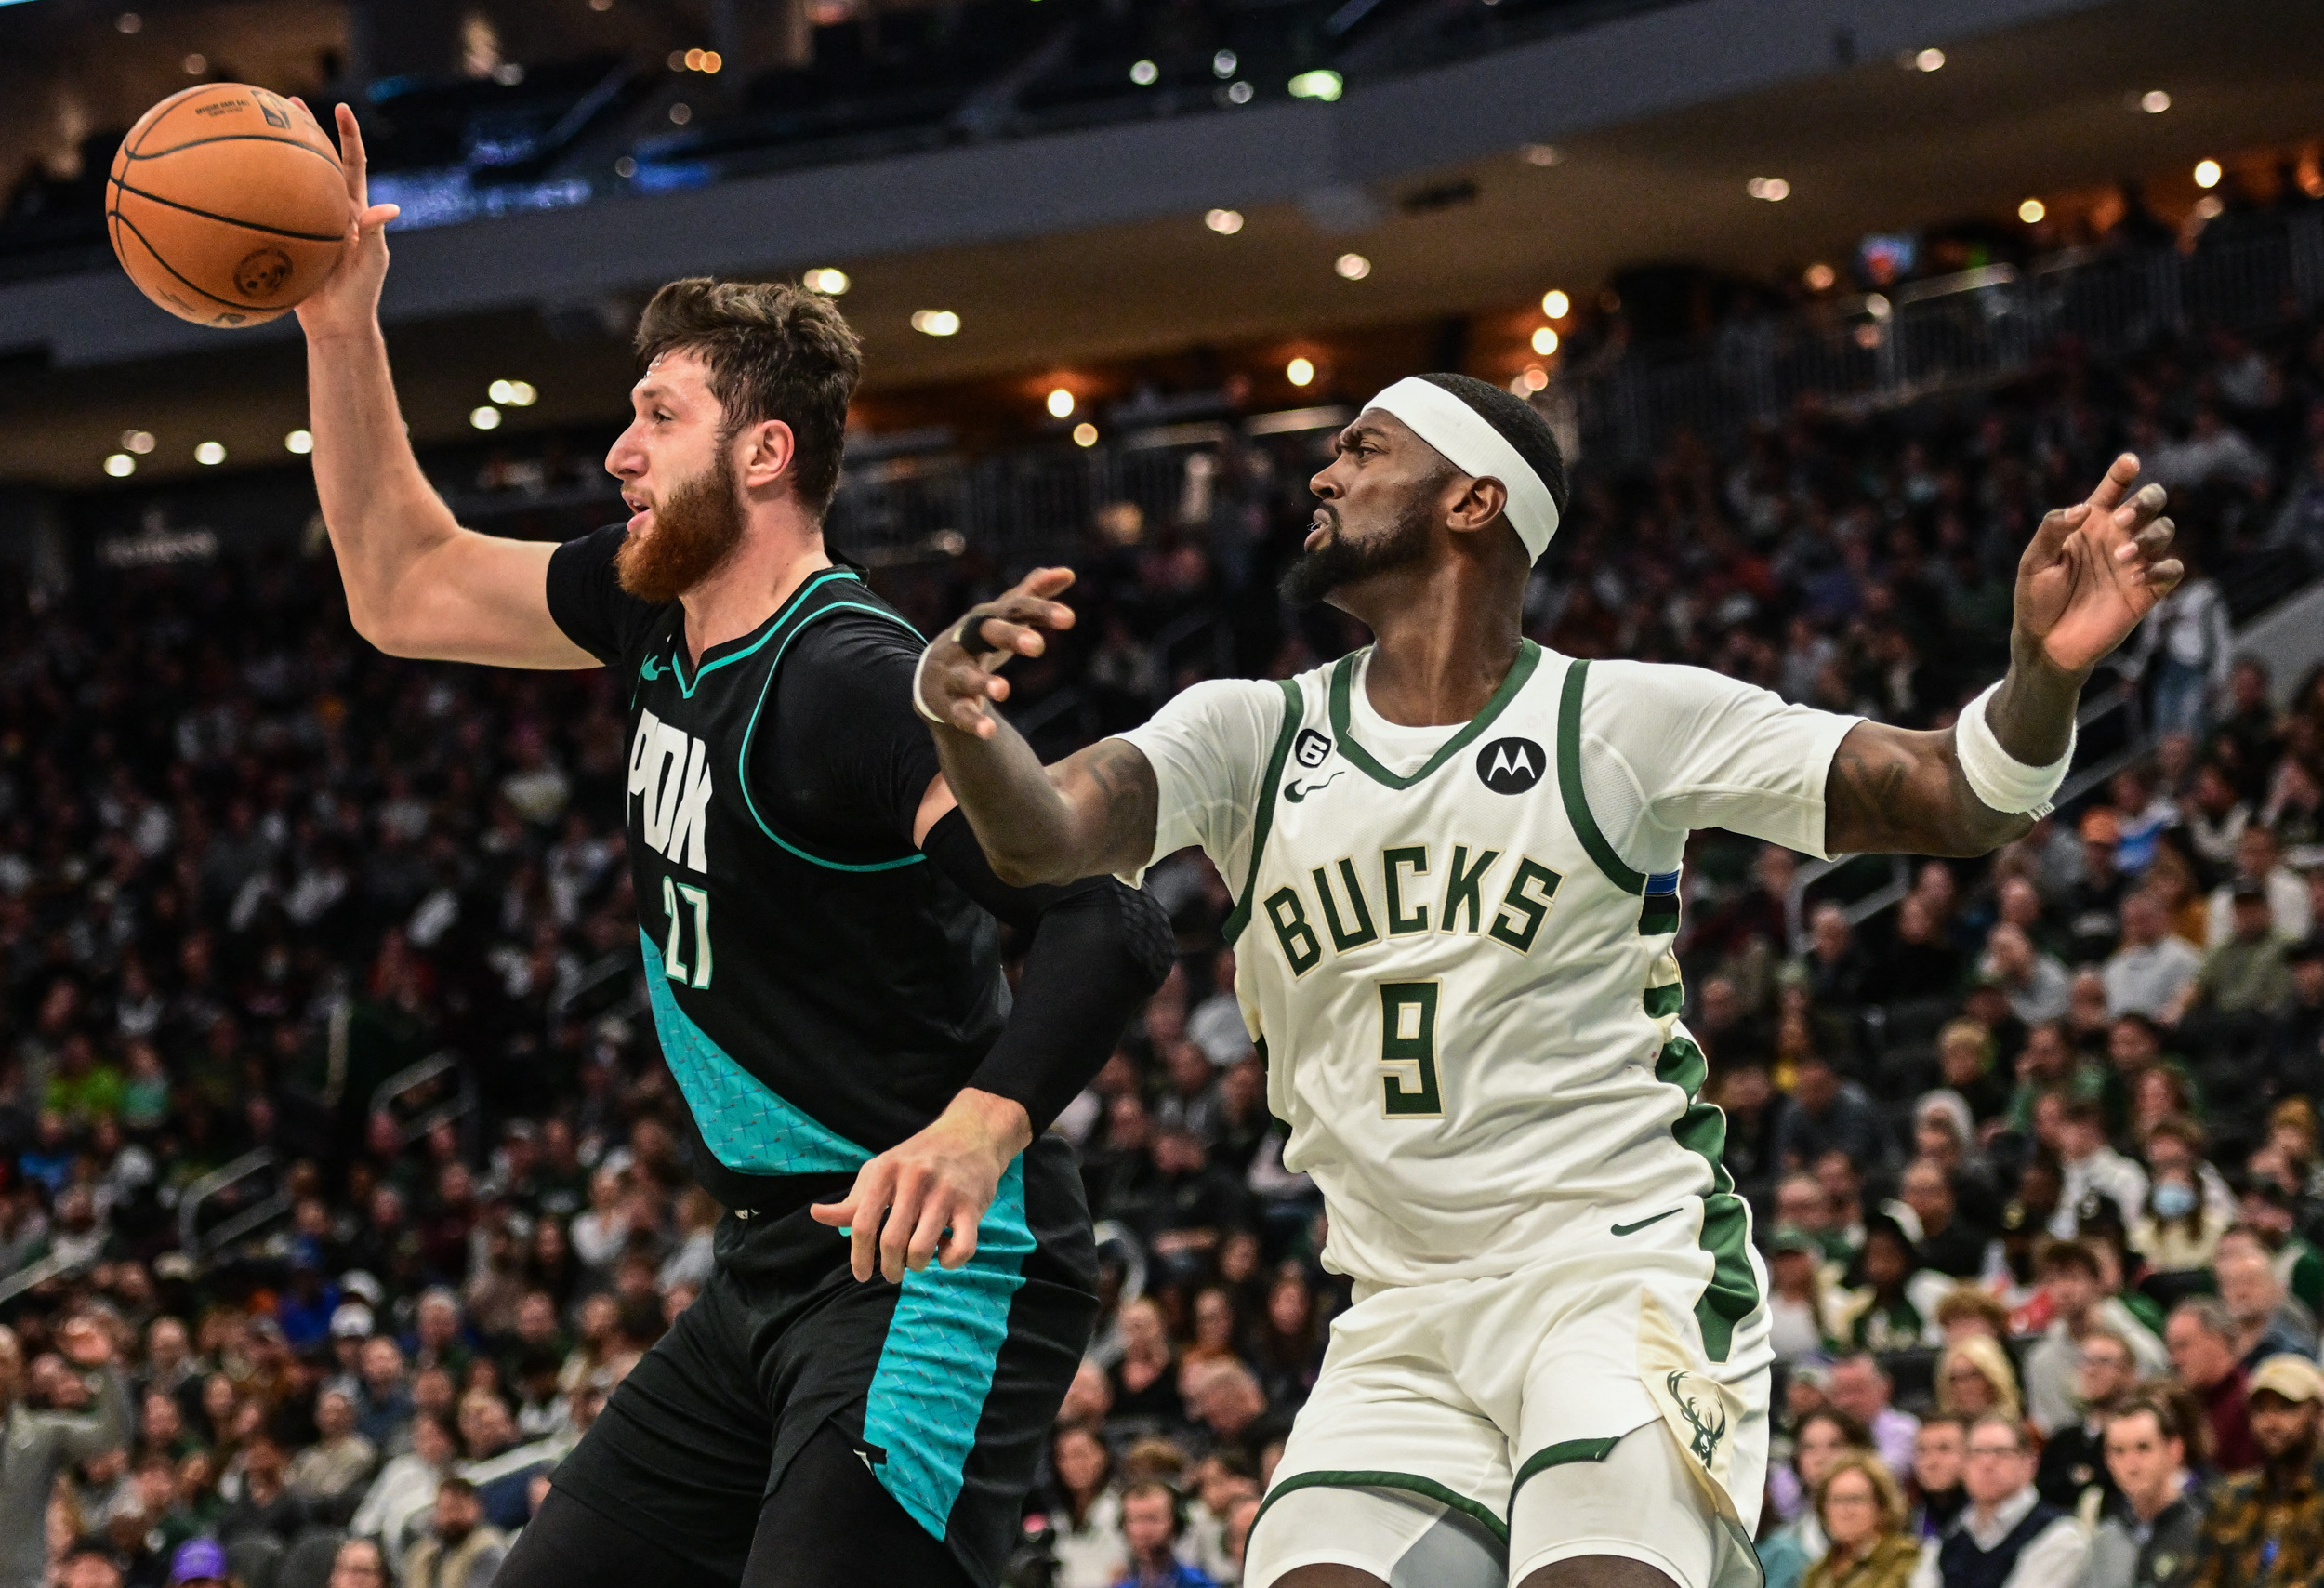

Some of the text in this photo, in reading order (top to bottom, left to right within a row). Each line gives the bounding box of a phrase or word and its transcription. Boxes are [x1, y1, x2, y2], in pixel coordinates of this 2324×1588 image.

[627, 708, 713, 874] PDX
[1299, 735, 1328, 766] 6
[663, 875, 713, 990] 27
[1262, 843, 1565, 982] BUCKS
[1376, 978, 1446, 1120] 9
